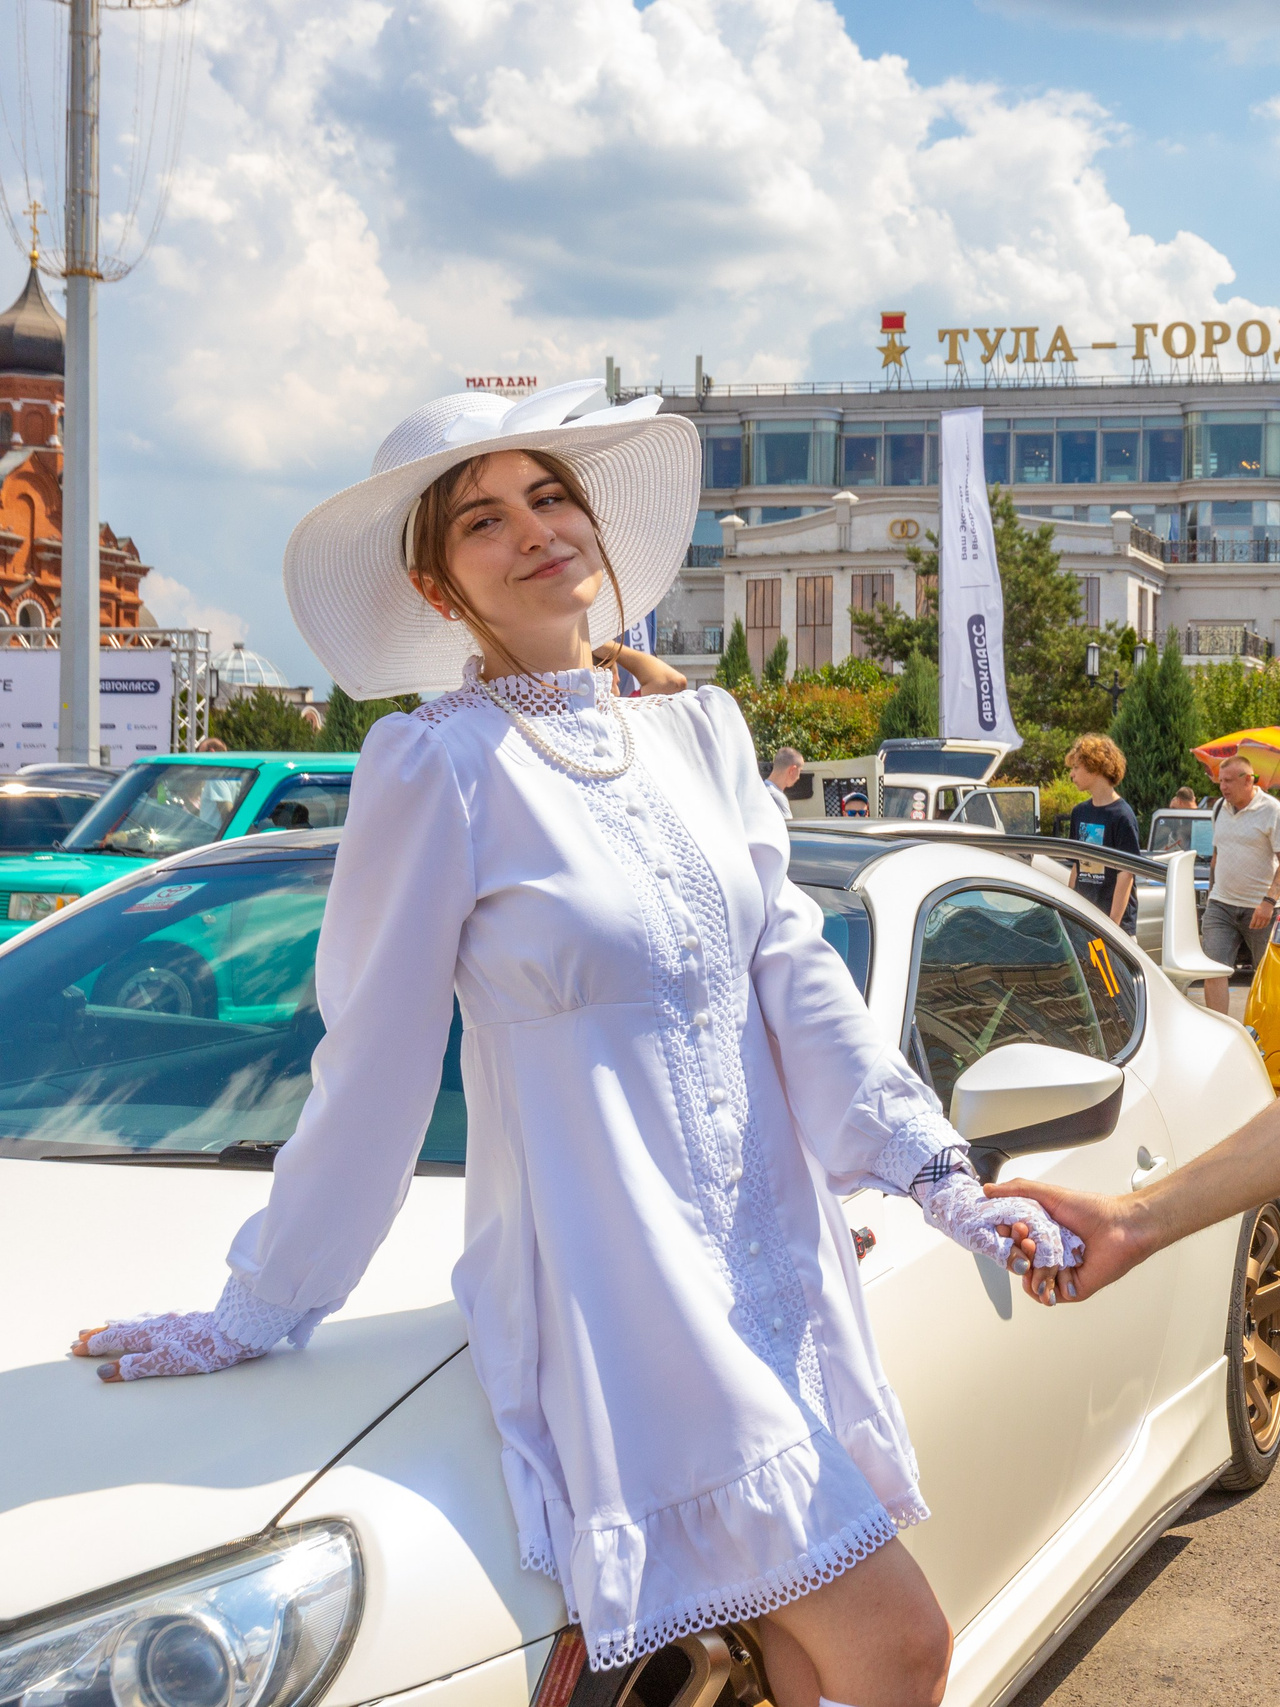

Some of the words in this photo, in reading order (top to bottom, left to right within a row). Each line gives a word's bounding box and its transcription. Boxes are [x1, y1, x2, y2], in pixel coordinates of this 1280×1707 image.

[937, 325, 1078, 365] ТУЛА
[465, 376, 537, 388] МАГАДАН
[972, 623, 994, 723] АВТОКЛАСС
[1088, 938, 1120, 998] 17
